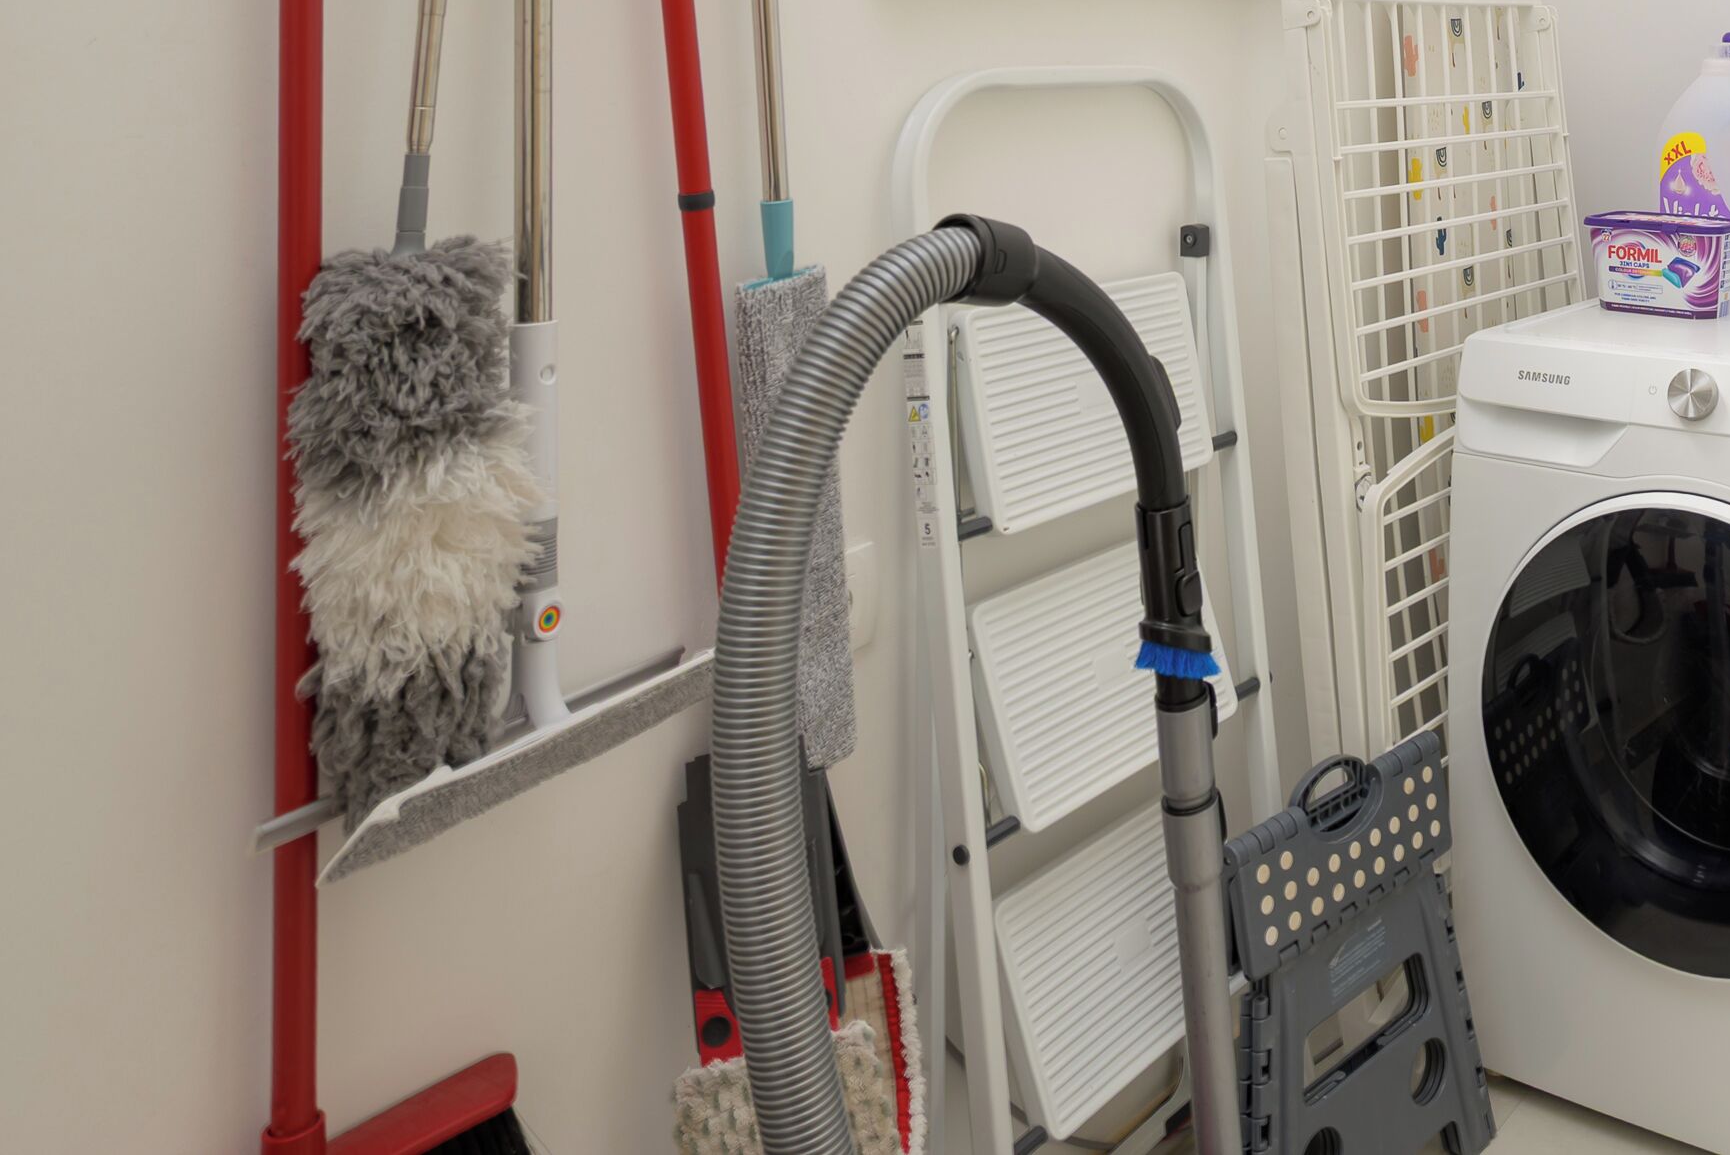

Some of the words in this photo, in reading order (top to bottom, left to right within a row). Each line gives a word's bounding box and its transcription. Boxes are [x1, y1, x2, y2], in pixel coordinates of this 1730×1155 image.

[1664, 141, 1692, 165] XXL
[1608, 244, 1662, 264] FORMIL
[1633, 261, 1650, 269] CAPS
[1517, 369, 1571, 386] SAMSUNG
[924, 522, 931, 535] 5
